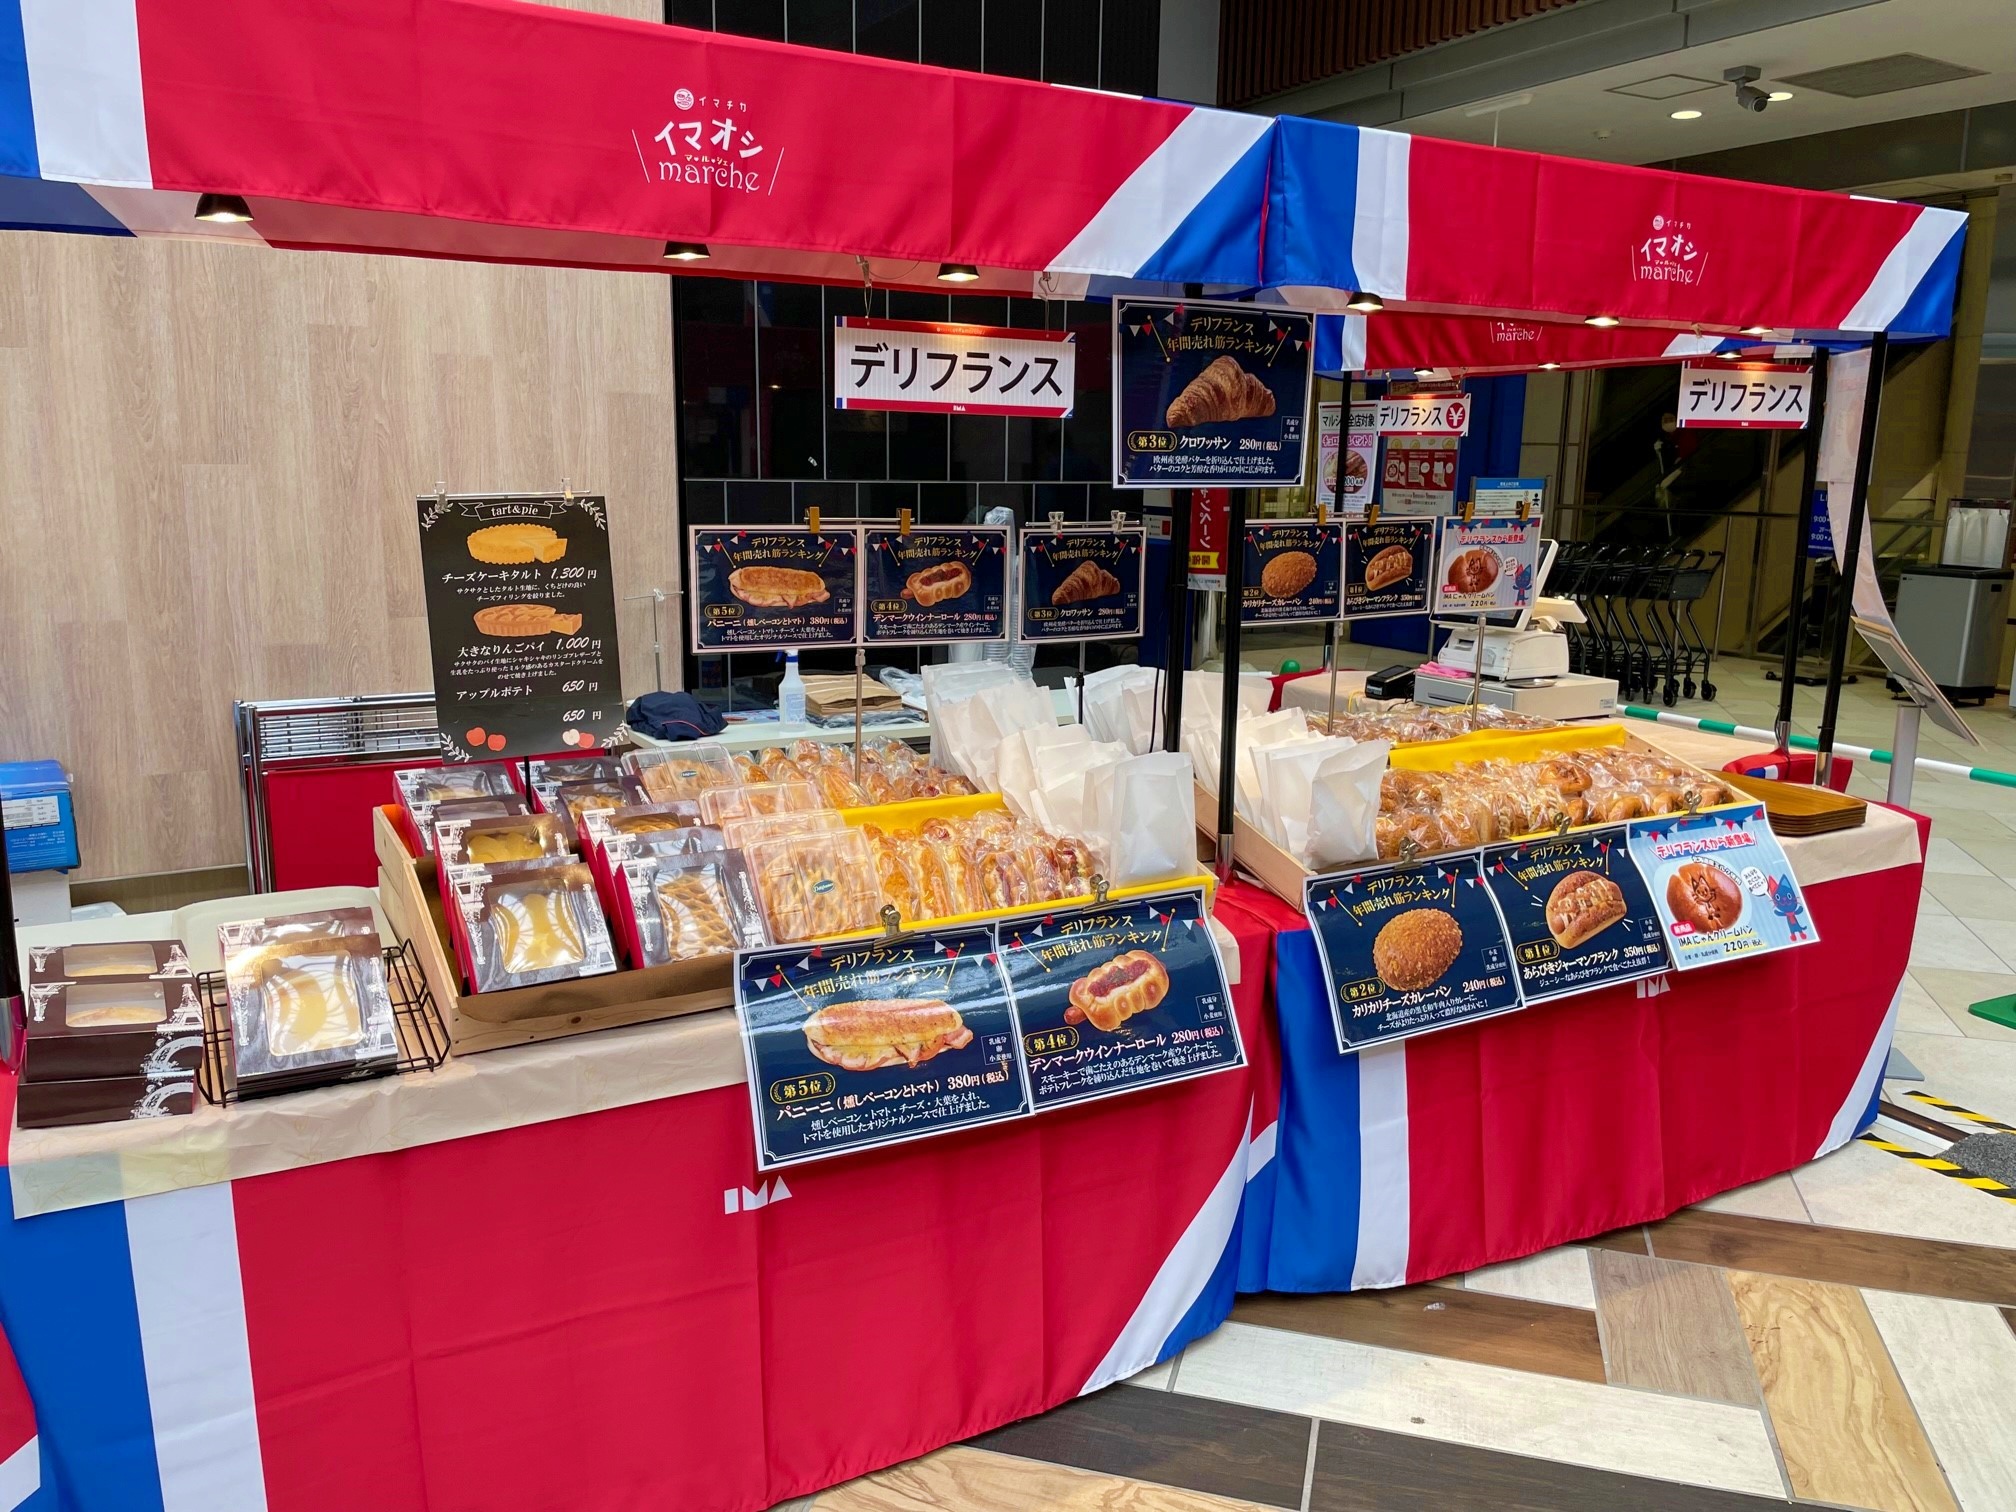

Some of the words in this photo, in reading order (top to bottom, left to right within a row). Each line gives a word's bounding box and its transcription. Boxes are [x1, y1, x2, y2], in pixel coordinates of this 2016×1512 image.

[698, 96, 747, 112] イマチカ
[654, 118, 764, 159] イマオシ
[659, 161, 761, 193] marche
[1640, 234, 1698, 261] イマオシ
[1640, 264, 1694, 285] marche
[1190, 316, 1254, 335] デリフランス
[1166, 335, 1275, 356] 年間売れ筋ランキング
[851, 342, 1063, 396] デリフランス
[1689, 378, 1803, 413] デリフランス
[1380, 406, 1442, 427] デリフランス
[1138, 434, 1167, 447] 第3位
[1179, 436, 1232, 450] クロワッサン
[491, 505, 539, 517] tart&pie
[751, 537, 805, 548] デリフランス
[914, 537, 962, 547] デリフランス
[1066, 538, 1106, 548] デリフランス
[1272, 529, 1308, 538] デリフランス
[733, 549, 825, 561] 年間売れ筋ランキング
[898, 548, 978, 560] 年間売れ筋ランキング
[441, 568, 542, 584] チーズケーキタルト
[587, 569, 597, 579] 円
[712, 607, 736, 616] 第5位
[1060, 609, 1093, 617] クロワッサン
[457, 640, 546, 658] 大きなりんごパイ
[591, 639, 601, 649] 円
[456, 684, 533, 701] アップルポテト
[562, 680, 585, 693] 650
[588, 682, 599, 692] 円
[562, 709, 586, 722] 650
[592, 711, 602, 721] 円
[1530, 843, 1582, 863] デリフランス
[1656, 832, 1754, 859] デリフランスから新登場
[1517, 857, 1603, 883] 年間売れ筋ランキング
[1367, 875, 1426, 896] デリフランス
[1352, 888, 1450, 917] 年間売れ筋ランキング
[1060, 915, 1134, 936] デリフランス
[1041, 930, 1162, 963] 年間売れ筋ランキング
[1524, 945, 1551, 960] 第1位
[829, 948, 915, 973] デリフランス
[1523, 948, 1619, 981] あらびきジャーマンフランク
[803, 964, 948, 999] 年間売れ筋ランキング
[1349, 983, 1376, 998] 第2位
[1636, 974, 1671, 999] IMA
[1352, 986, 1452, 1018] カリカリチーズカレーパン
[1033, 1034, 1068, 1053] 第4位
[1029, 1033, 1167, 1075] デンマークウインナーロール
[783, 1080, 823, 1098] 第5位
[776, 1103, 835, 1121] パニーニ
[724, 1175, 793, 1215] IMA
